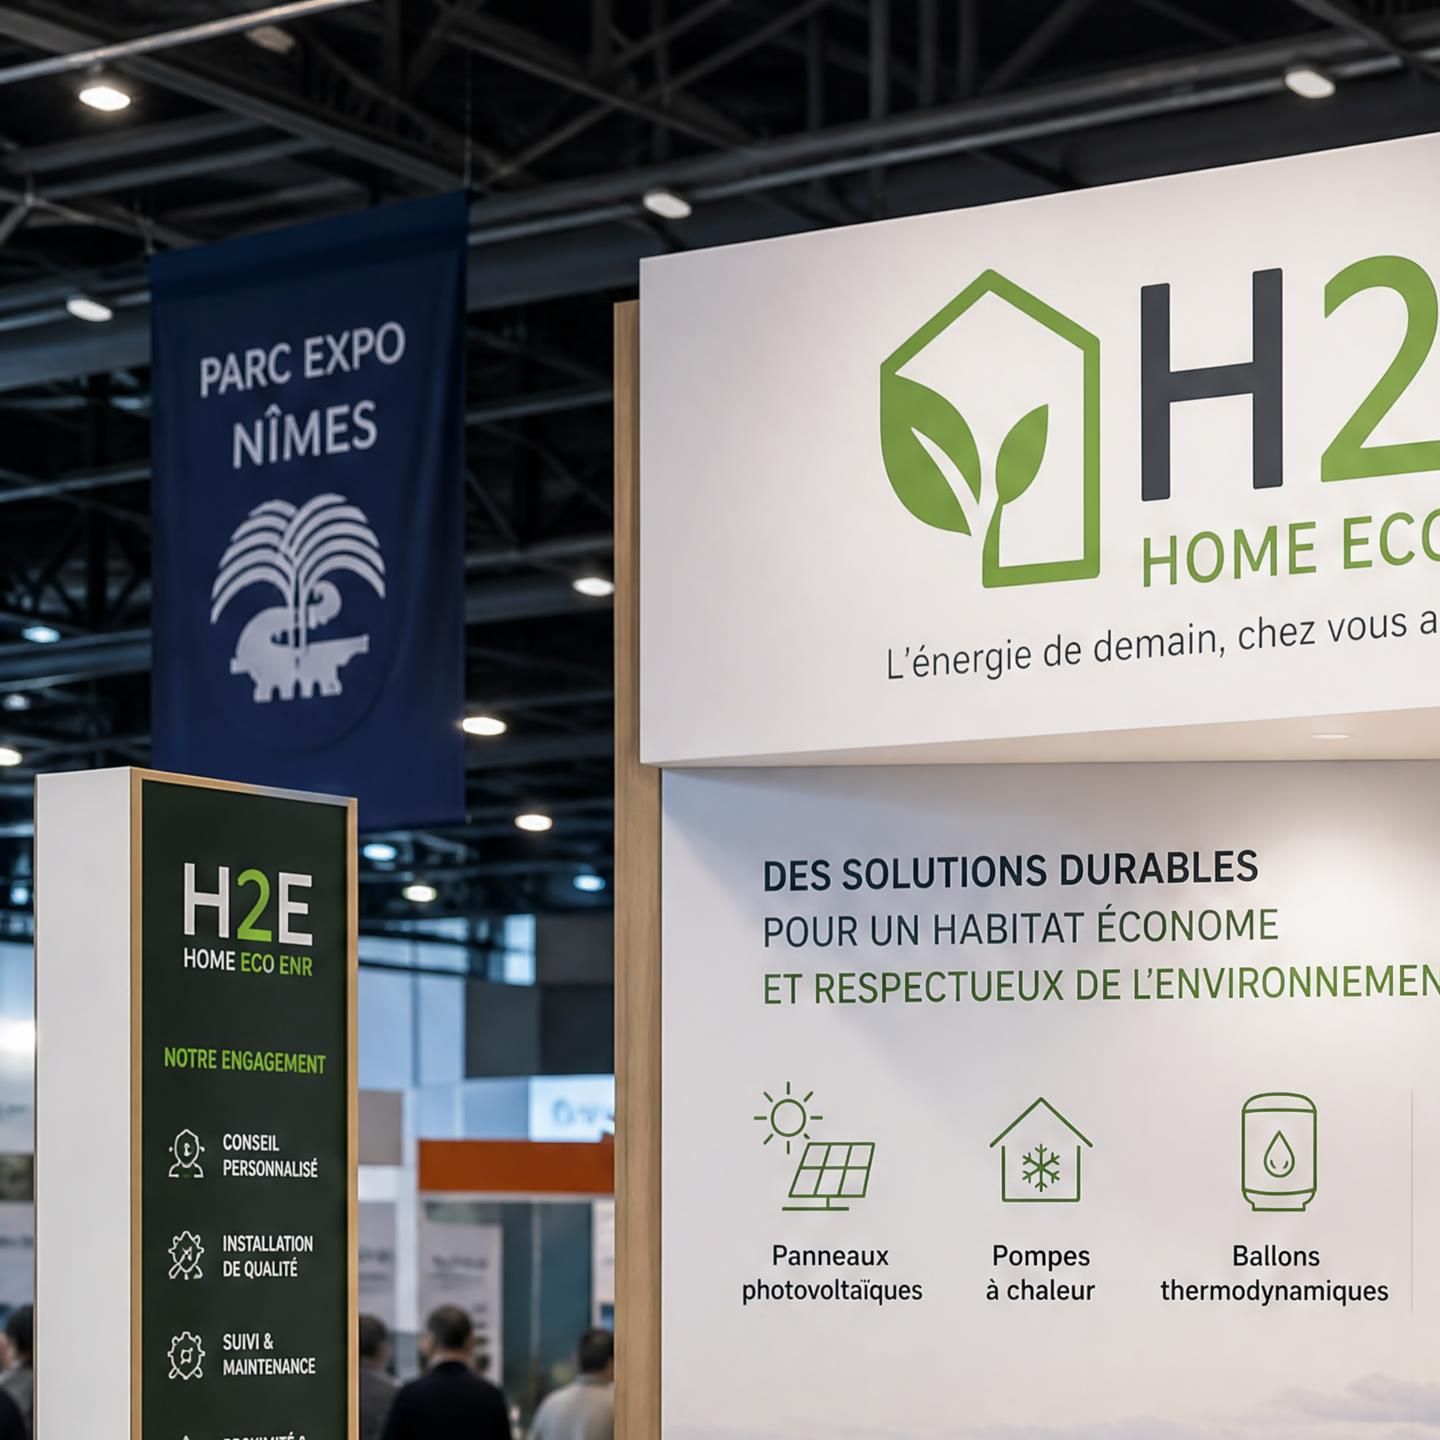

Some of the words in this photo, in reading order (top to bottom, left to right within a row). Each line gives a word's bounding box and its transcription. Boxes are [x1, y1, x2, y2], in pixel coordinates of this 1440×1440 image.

[201, 343, 291, 397] PARC
[304, 322, 405, 378] EXPO
[233, 400, 377, 469] NÎMES
[1144, 522, 1316, 587] HOME
[1044, 634, 1081, 666] de
[1094, 623, 1224, 662] demain,
[1239, 617, 1315, 649] chez
[1327, 612, 1407, 643] vous
[765, 860, 830, 891] DES
[843, 855, 1046, 890] SOLUTIONS
[1061, 850, 1257, 885] DURABLES
[184, 863, 312, 946] H2E
[765, 916, 857, 947] POUR
[872, 915, 918, 946] UN
[935, 912, 1084, 944] HABITAT
[1098, 904, 1278, 942] ÉCONOME
[184, 948, 235, 971] HOME
[241, 952, 274, 973] ECO
[280, 955, 312, 976] ENR
[765, 974, 803, 1004] ET
[816, 970, 1063, 1003] RESPECTUEUX
[1077, 969, 1120, 1000] DE
[165, 1047, 216, 1068] NOTRE
[222, 1050, 326, 1073] ENGAGEMENT
[223, 1134, 279, 1151] CONSEIL
[224, 1158, 318, 1177] PERSONNALISÉ
[224, 1235, 312, 1252] INSTALLATION
[774, 1245, 888, 1265] Panneaux
[1234, 1245, 1319, 1266] Ballons
[224, 1261, 240, 1277] DE
[245, 1257, 297, 1279] QUALITÉ
[994, 1245, 1090, 1271] Pompes
[743, 1279, 922, 1305] photovoltaïques
[987, 1279, 998, 1300] à
[1008, 1279, 1095, 1300] chaleur
[1161, 1279, 1388, 1306] thermodynamiques
[223, 1333, 259, 1350] SUIVI
[264, 1333, 273, 1349] &
[224, 1358, 315, 1375] MAINTENANCE
